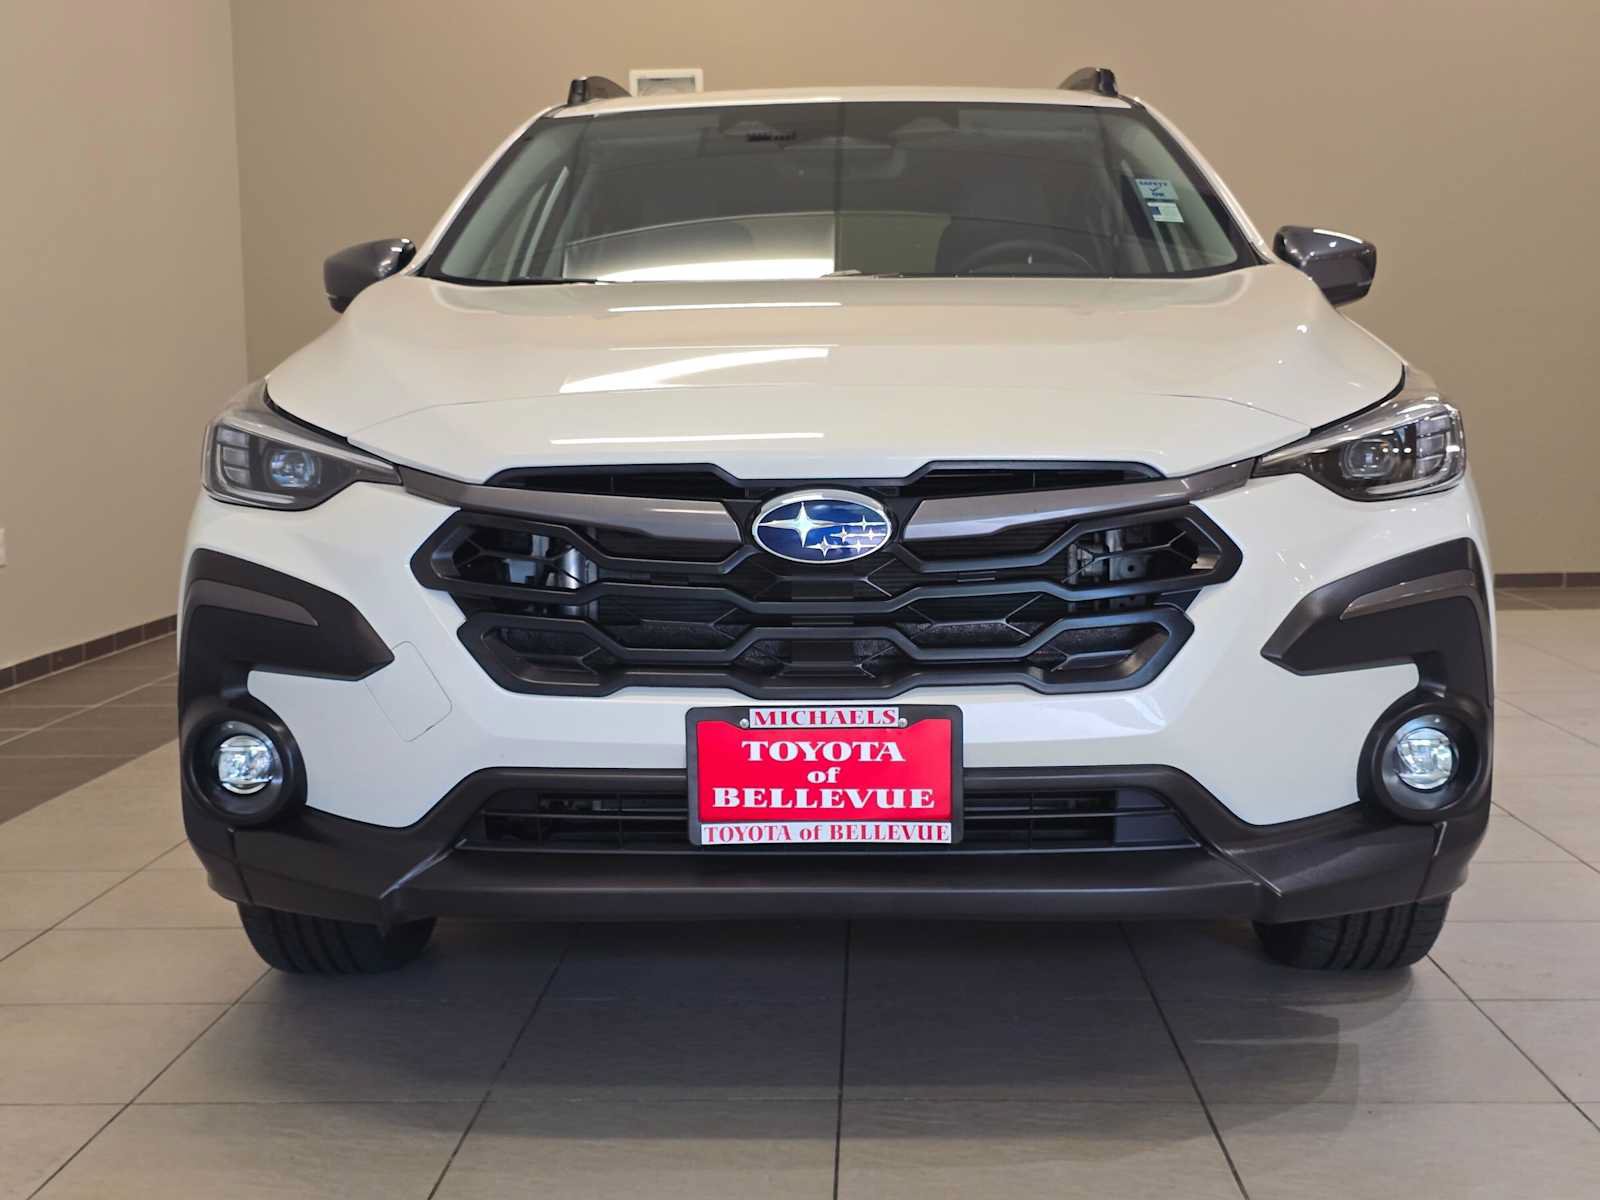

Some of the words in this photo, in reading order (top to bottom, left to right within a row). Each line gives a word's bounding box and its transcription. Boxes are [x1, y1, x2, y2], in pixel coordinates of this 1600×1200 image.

[754, 710, 896, 726] MICHAELS
[741, 741, 906, 762] TOYOTA
[807, 767, 841, 784] of
[712, 787, 935, 809] BELLEVUE
[704, 825, 793, 843] TOYOTA
[800, 825, 822, 841] of
[830, 824, 949, 841] BELLEVUE
